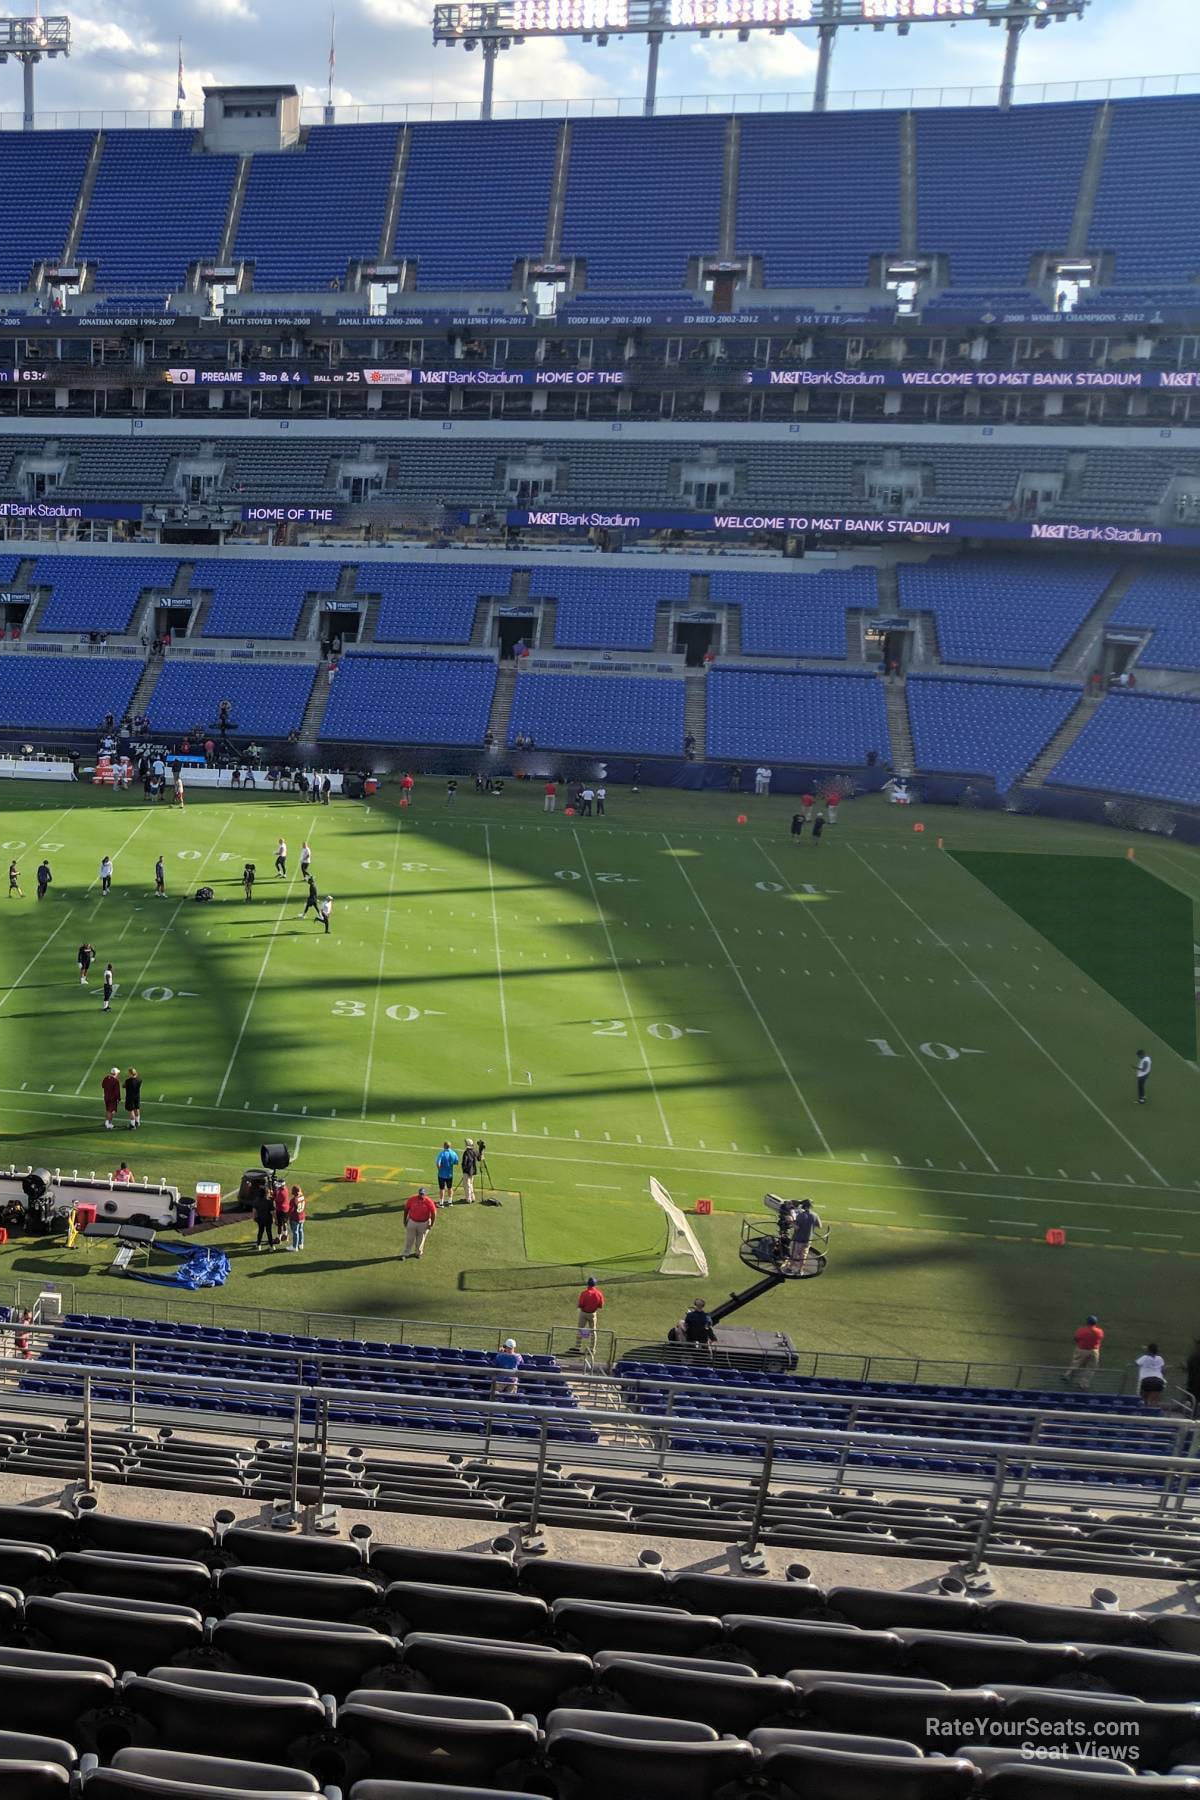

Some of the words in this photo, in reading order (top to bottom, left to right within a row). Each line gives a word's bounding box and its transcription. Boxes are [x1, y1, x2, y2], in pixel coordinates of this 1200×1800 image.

[78, 318, 114, 326] JONATHAN
[115, 318, 138, 326] OGDEN
[140, 318, 175, 326] 1996-2007
[338, 317, 361, 325] JAMAL
[452, 317, 464, 325] RAY
[465, 317, 488, 325] LEWIS
[567, 316, 587, 324] TODD
[589, 316, 610, 324] HEAP
[795, 315, 840, 323] SMYTH
[179, 372, 188, 381] 0
[201, 372, 243, 382] PREGAME
[258, 372, 278, 382] 3RD
[280, 372, 289, 381] &
[292, 372, 301, 381] 4
[346, 372, 360, 381] 25
[419, 371, 448, 383] M&T
[448, 371, 477, 383] Bank
[477, 372, 523, 383] Stadium
[536, 372, 573, 383] HOME
[576, 372, 595, 383] OF
[597, 372, 622, 383] THE
[770, 371, 802, 384] M&T
[802, 372, 833, 384] Bank
[833, 372, 885, 384] Stadium
[902, 373, 973, 385] WELCOME
[976, 373, 996, 384] TO
[998, 373, 1030, 385] M&T
[1032, 373, 1073, 385] BANK
[1075, 373, 1141, 385] STADIUM
[1159, 372, 1195, 386] M&T
[10, 504, 37, 516] Bank
[38, 504, 81, 517] Stadium
[248, 509, 284, 519] HOME
[287, 509, 305, 519] OF
[308, 510, 333, 520] THE
[527, 512, 560, 525] M&T
[560, 513, 589, 525] Bank
[590, 513, 640, 526] Stadium
[713, 517, 784, 529] WELCOME
[788, 518, 808, 529] TO
[811, 519, 842, 530] M&T
[844, 520, 883, 532] BANK
[887, 521, 950, 534] STADIUM
[1030, 524, 1068, 538] M&T
[1068, 525, 1104, 540] Bank
[1104, 527, 1162, 543] Stadium
[331, 1000, 420, 1021] 30
[591, 1019, 683, 1040] 20
[865, 1038, 960, 1060] 10
[345, 1168, 358, 1180] 30
